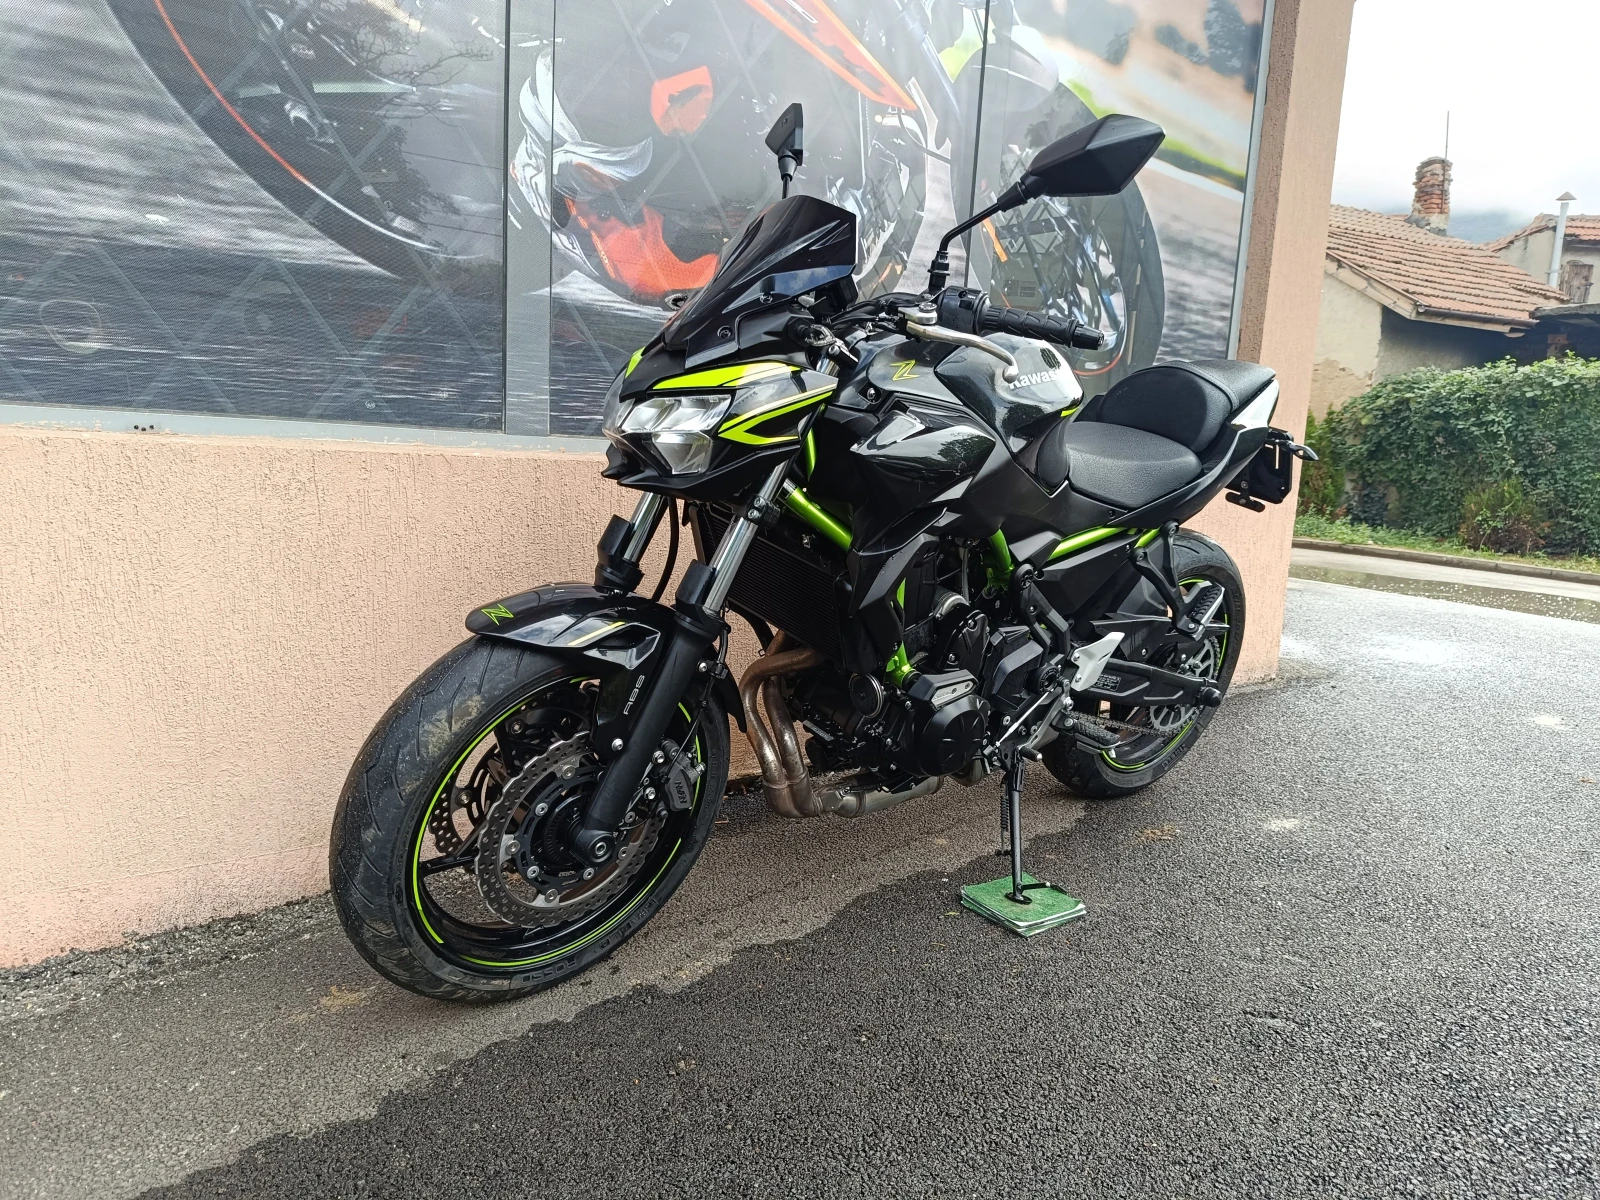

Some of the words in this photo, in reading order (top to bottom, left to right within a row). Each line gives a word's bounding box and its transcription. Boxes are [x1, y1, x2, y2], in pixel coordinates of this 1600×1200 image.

[890, 359, 920, 381] Z
[623, 674, 645, 715] ABS
[522, 960, 577, 984] ROSSO
